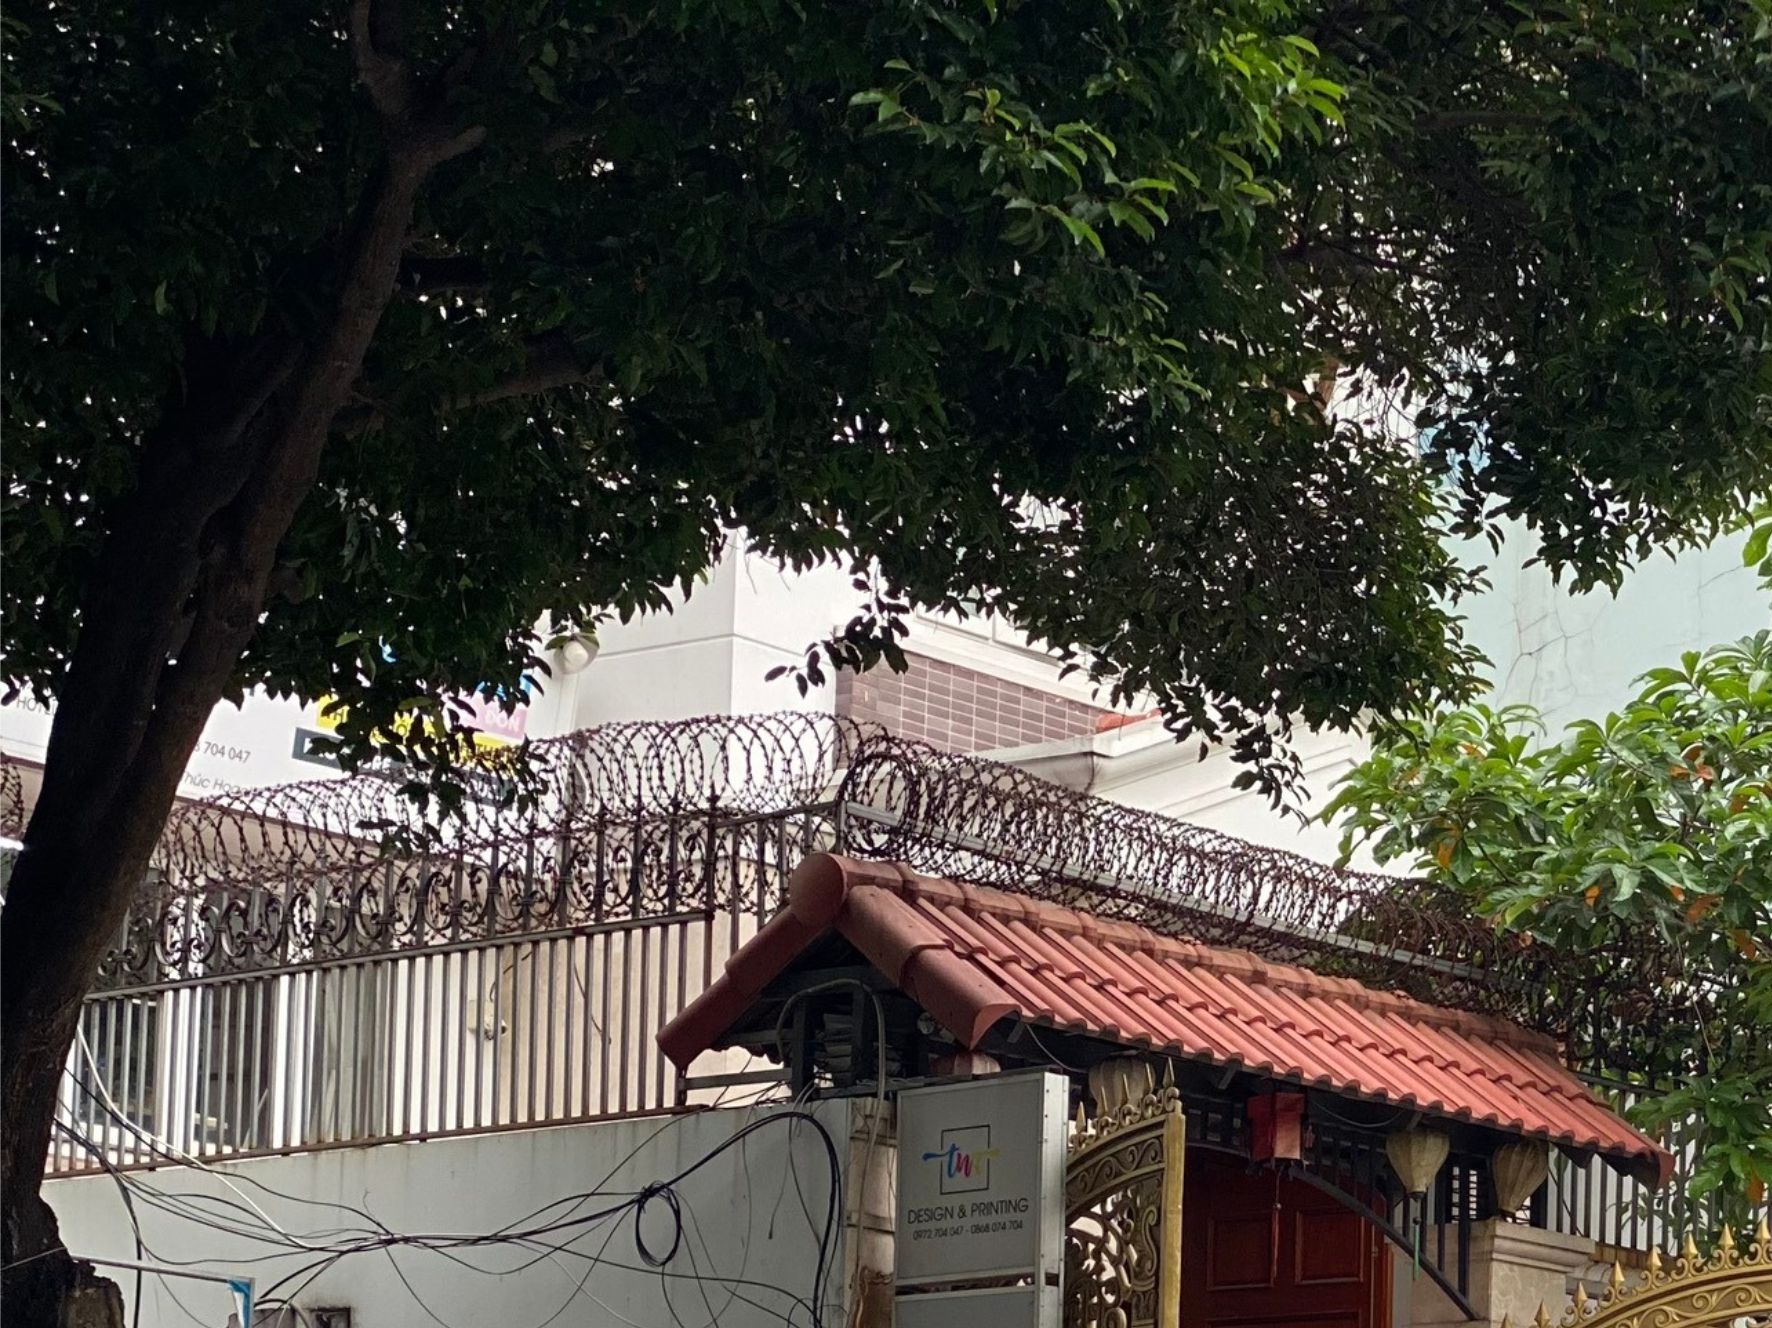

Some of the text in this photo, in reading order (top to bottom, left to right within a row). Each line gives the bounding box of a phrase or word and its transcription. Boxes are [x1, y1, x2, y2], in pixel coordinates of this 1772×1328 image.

[203, 741, 251, 763] 704 047
[907, 1198, 1029, 1225] DESIGN & PRINTING
